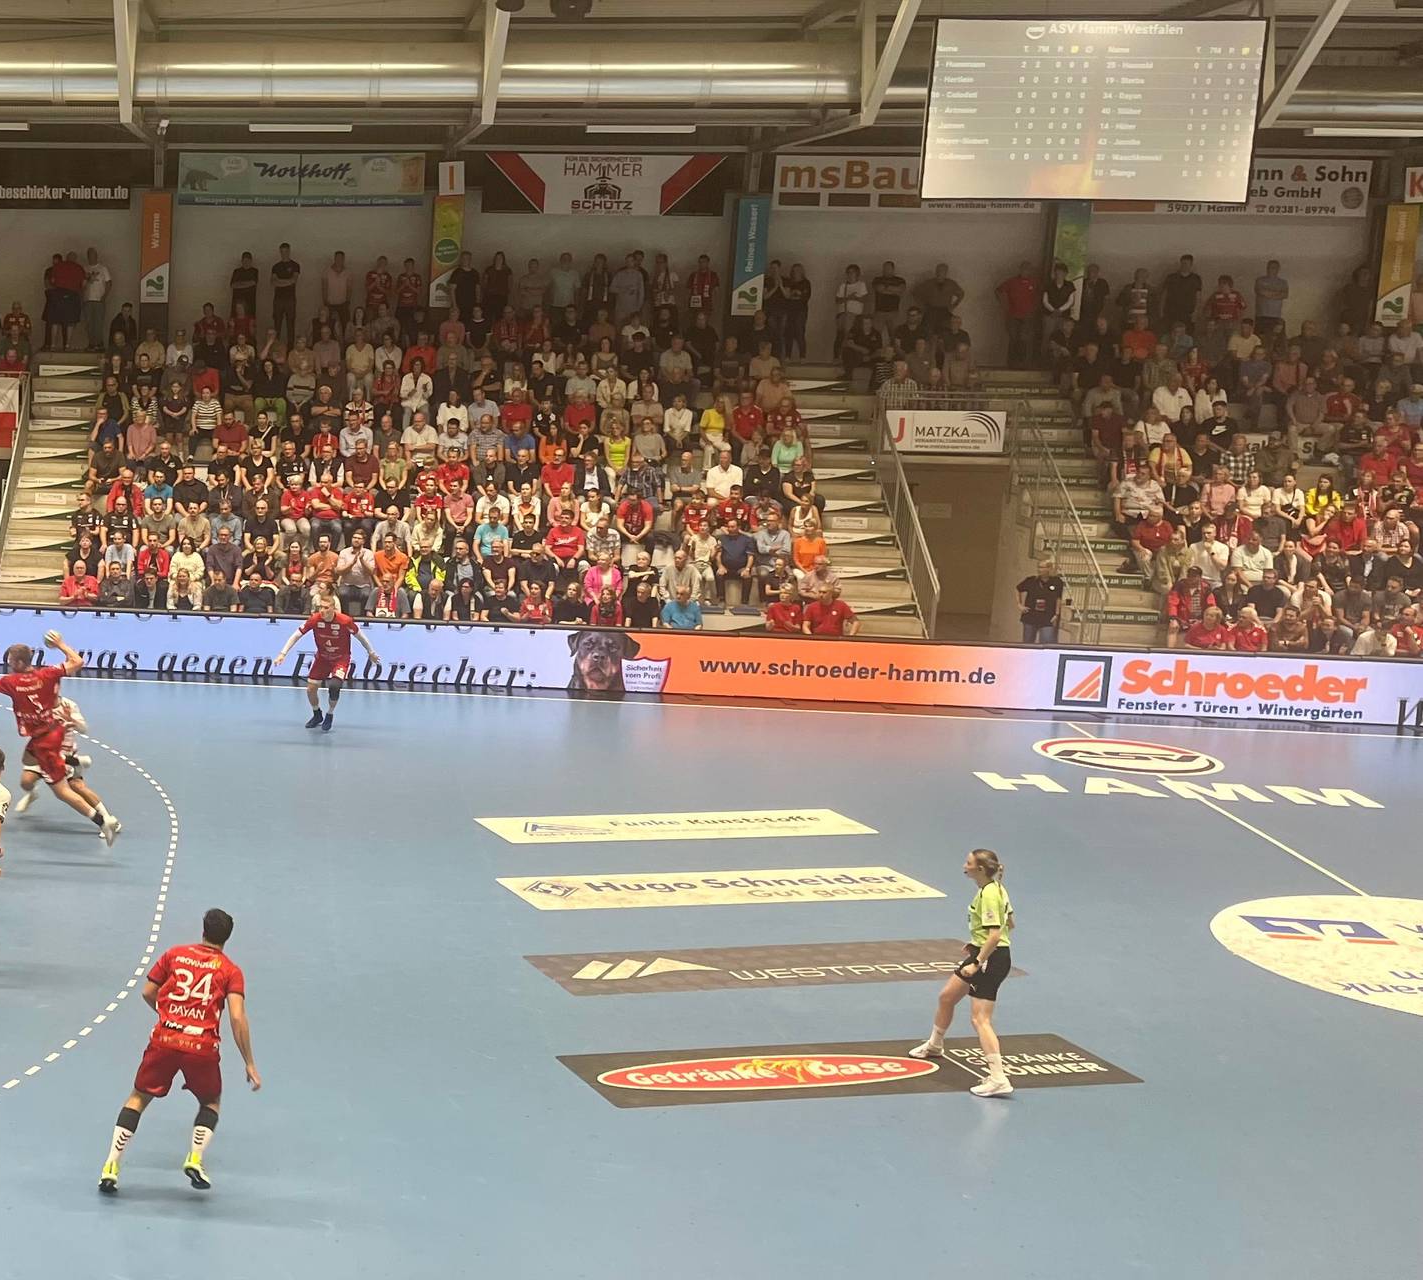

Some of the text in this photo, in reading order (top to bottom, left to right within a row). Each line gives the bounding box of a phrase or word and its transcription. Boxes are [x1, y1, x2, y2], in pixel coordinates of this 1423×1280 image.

[1048, 23, 1184, 36] ASV Hamm-Westfalen
[563, 162, 643, 177] HAMMER
[779, 159, 919, 189] msBau
[1290, 165, 1368, 183] & Sohn
[1273, 186, 1322, 200] GmbH
[1268, 205, 1336, 215] 02381-89794
[745, 242, 755, 273] Reines
[892, 417, 906, 444] J
[914, 426, 970, 438] MATZKA
[625, 663, 663, 673] Sicherheit
[698, 658, 997, 686] www.schroeder-hamm.de
[1118, 659, 1369, 704] Schroeder
[1116, 698, 1364, 721] Fenster Türen Wintergärten
[972, 771, 1386, 809] HAMM
[608, 814, 822, 828] Funke Kunststoffe
[584, 874, 899, 894] Hugo Schneider
[747, 887, 805, 899] Gut
[728, 960, 967, 981] WESTPRES
[167, 968, 214, 1006] 34
[168, 1003, 206, 1021] DAYAN
[625, 1061, 780, 1087] Getränke
